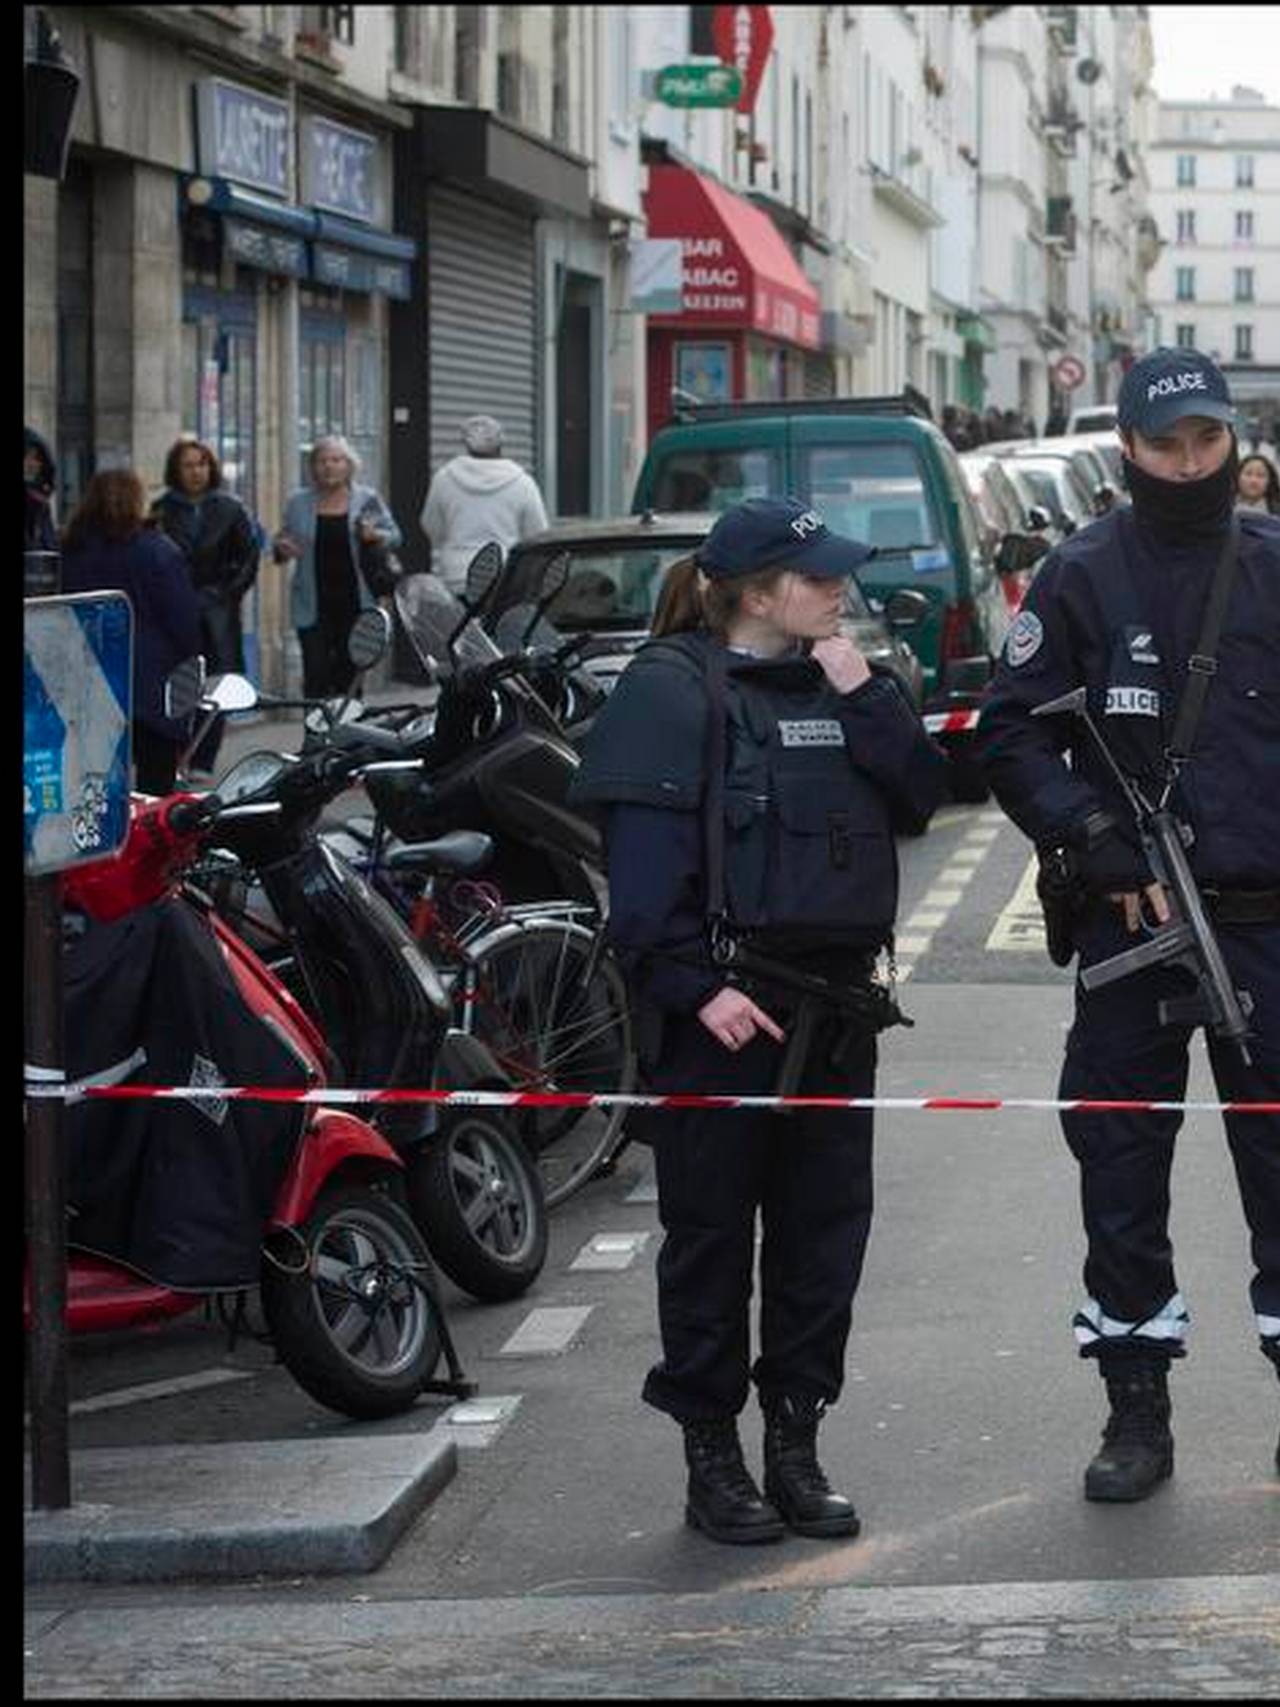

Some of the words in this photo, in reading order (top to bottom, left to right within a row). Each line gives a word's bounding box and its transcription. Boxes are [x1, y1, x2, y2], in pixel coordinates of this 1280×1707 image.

[682, 267, 739, 287] ABAC
[1147, 371, 1207, 401] POLICE
[1106, 691, 1158, 712] OLICE
